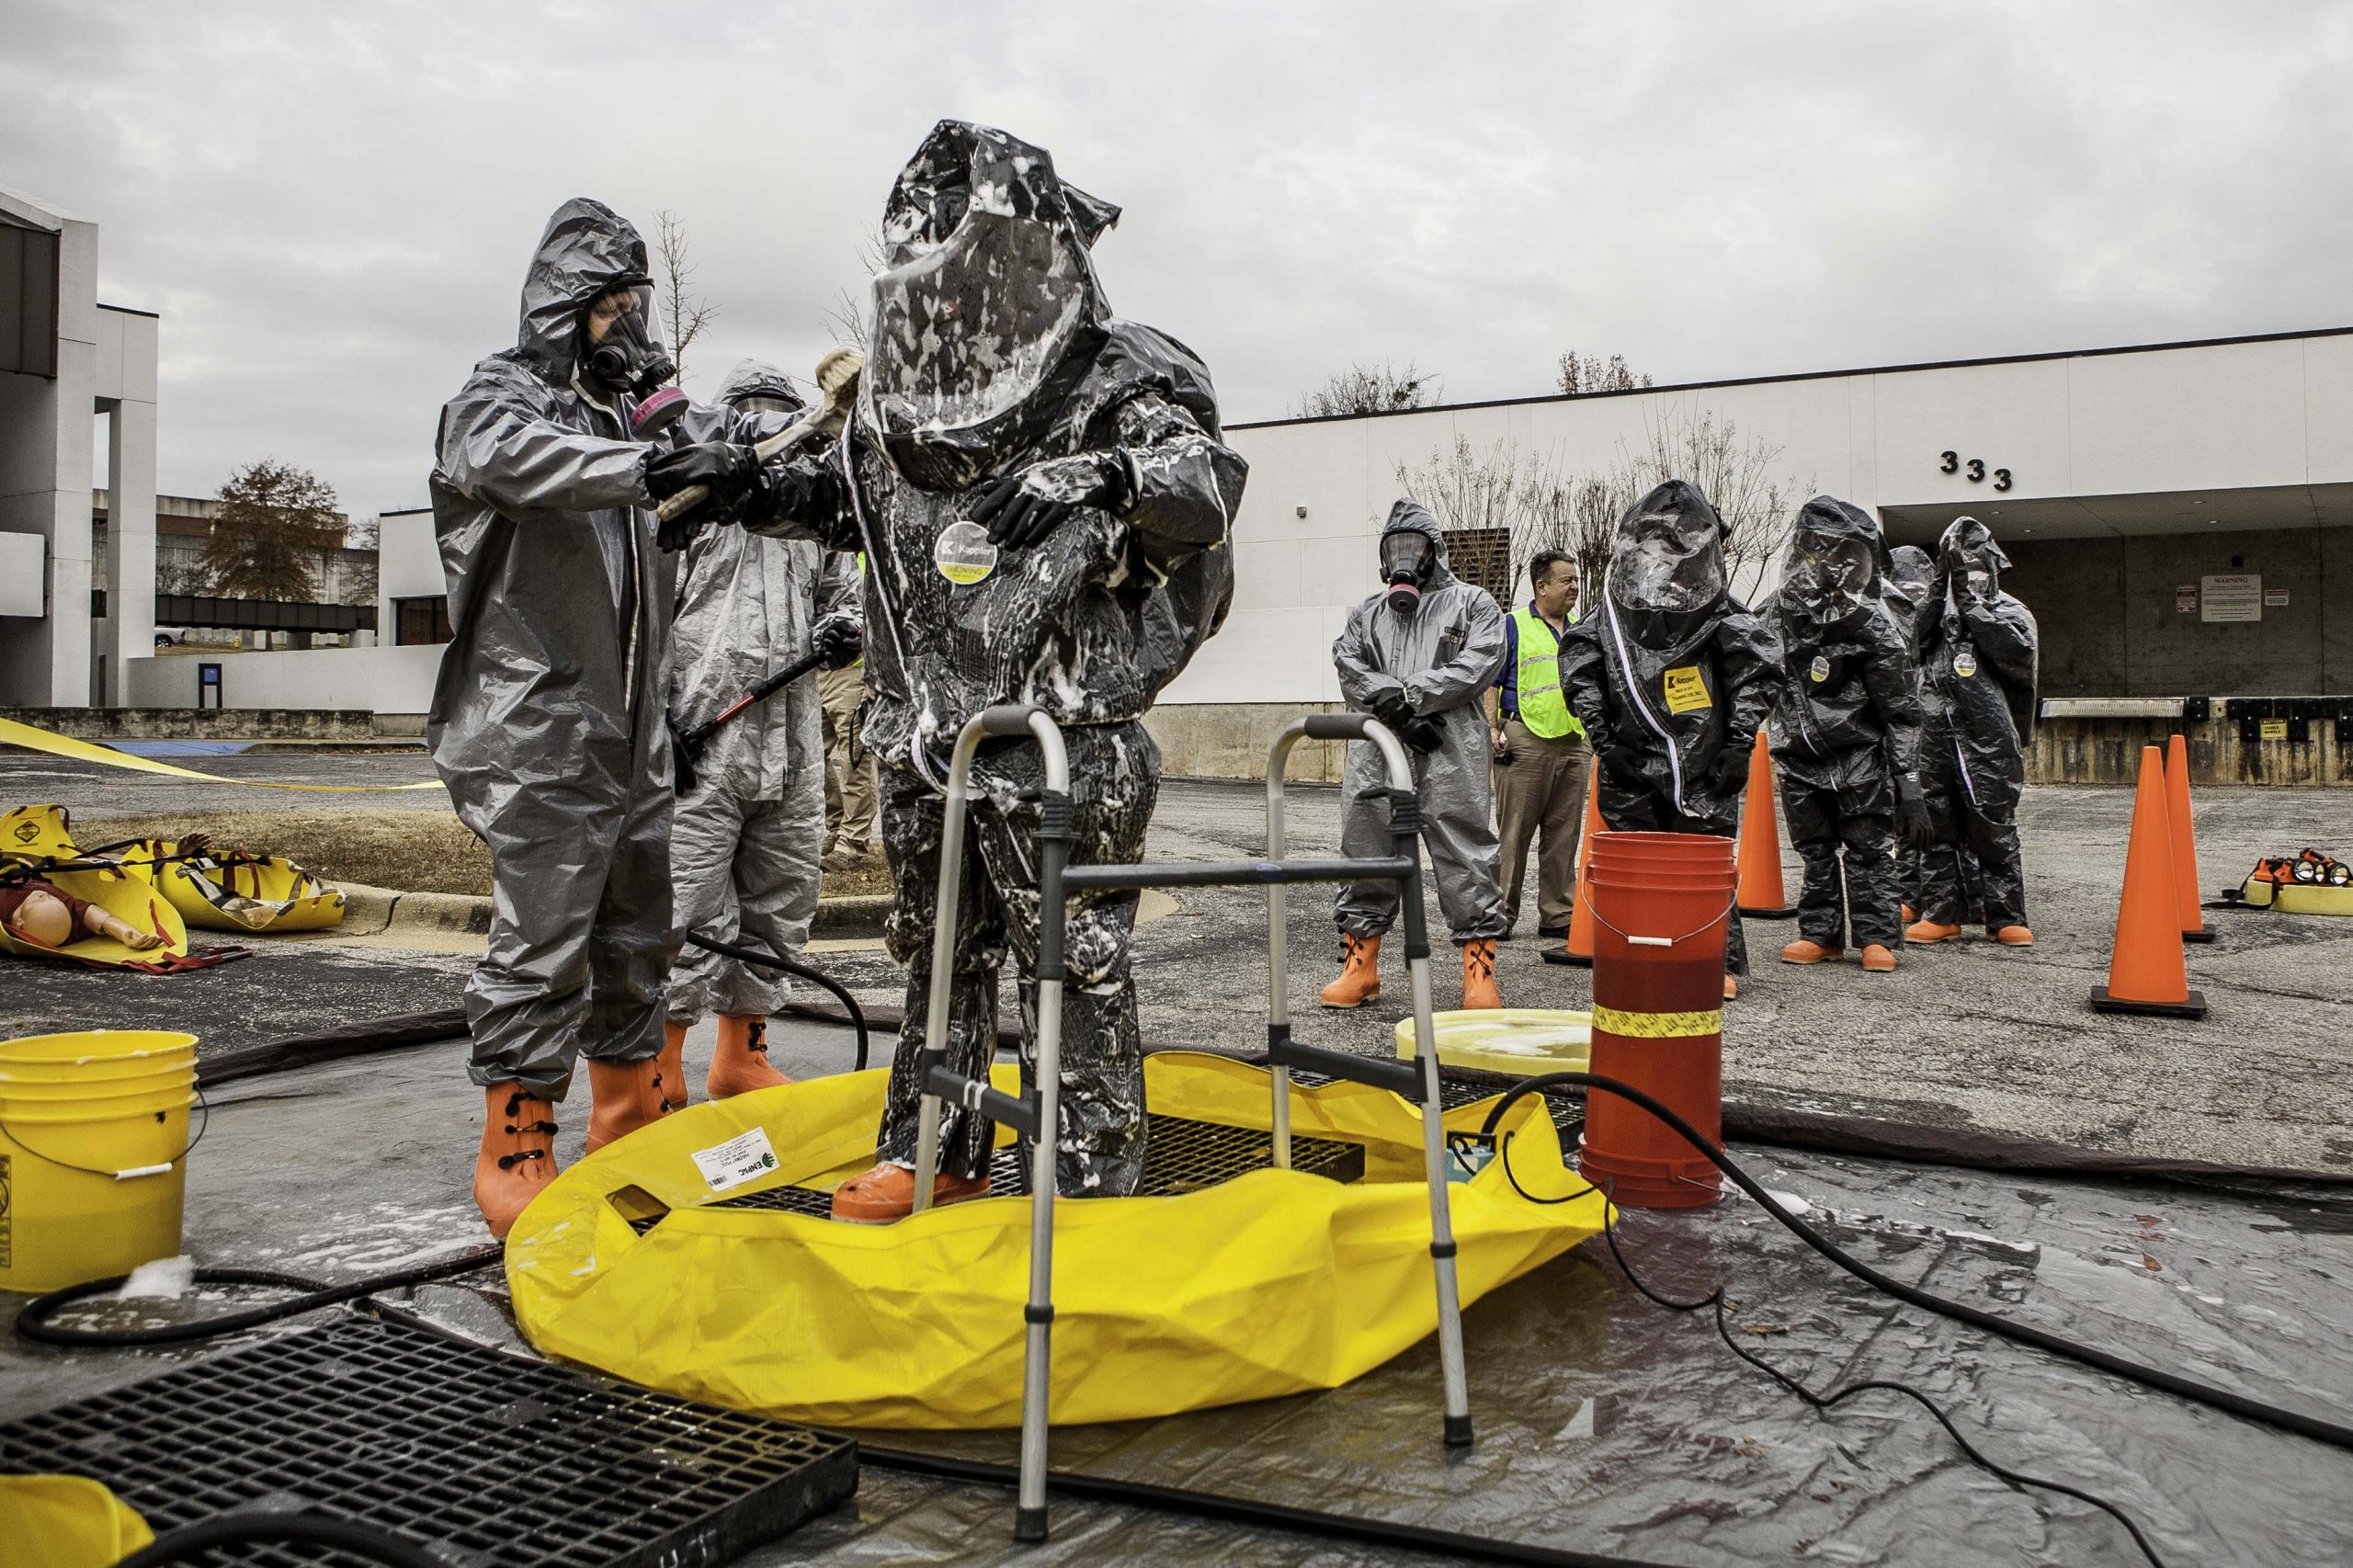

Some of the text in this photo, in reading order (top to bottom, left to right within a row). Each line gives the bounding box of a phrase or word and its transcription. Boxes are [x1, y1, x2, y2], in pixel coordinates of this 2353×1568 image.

[1939, 450, 2012, 492] 333
[959, 543, 991, 556] Kappler
[737, 1161, 763, 1176] ENPAC
